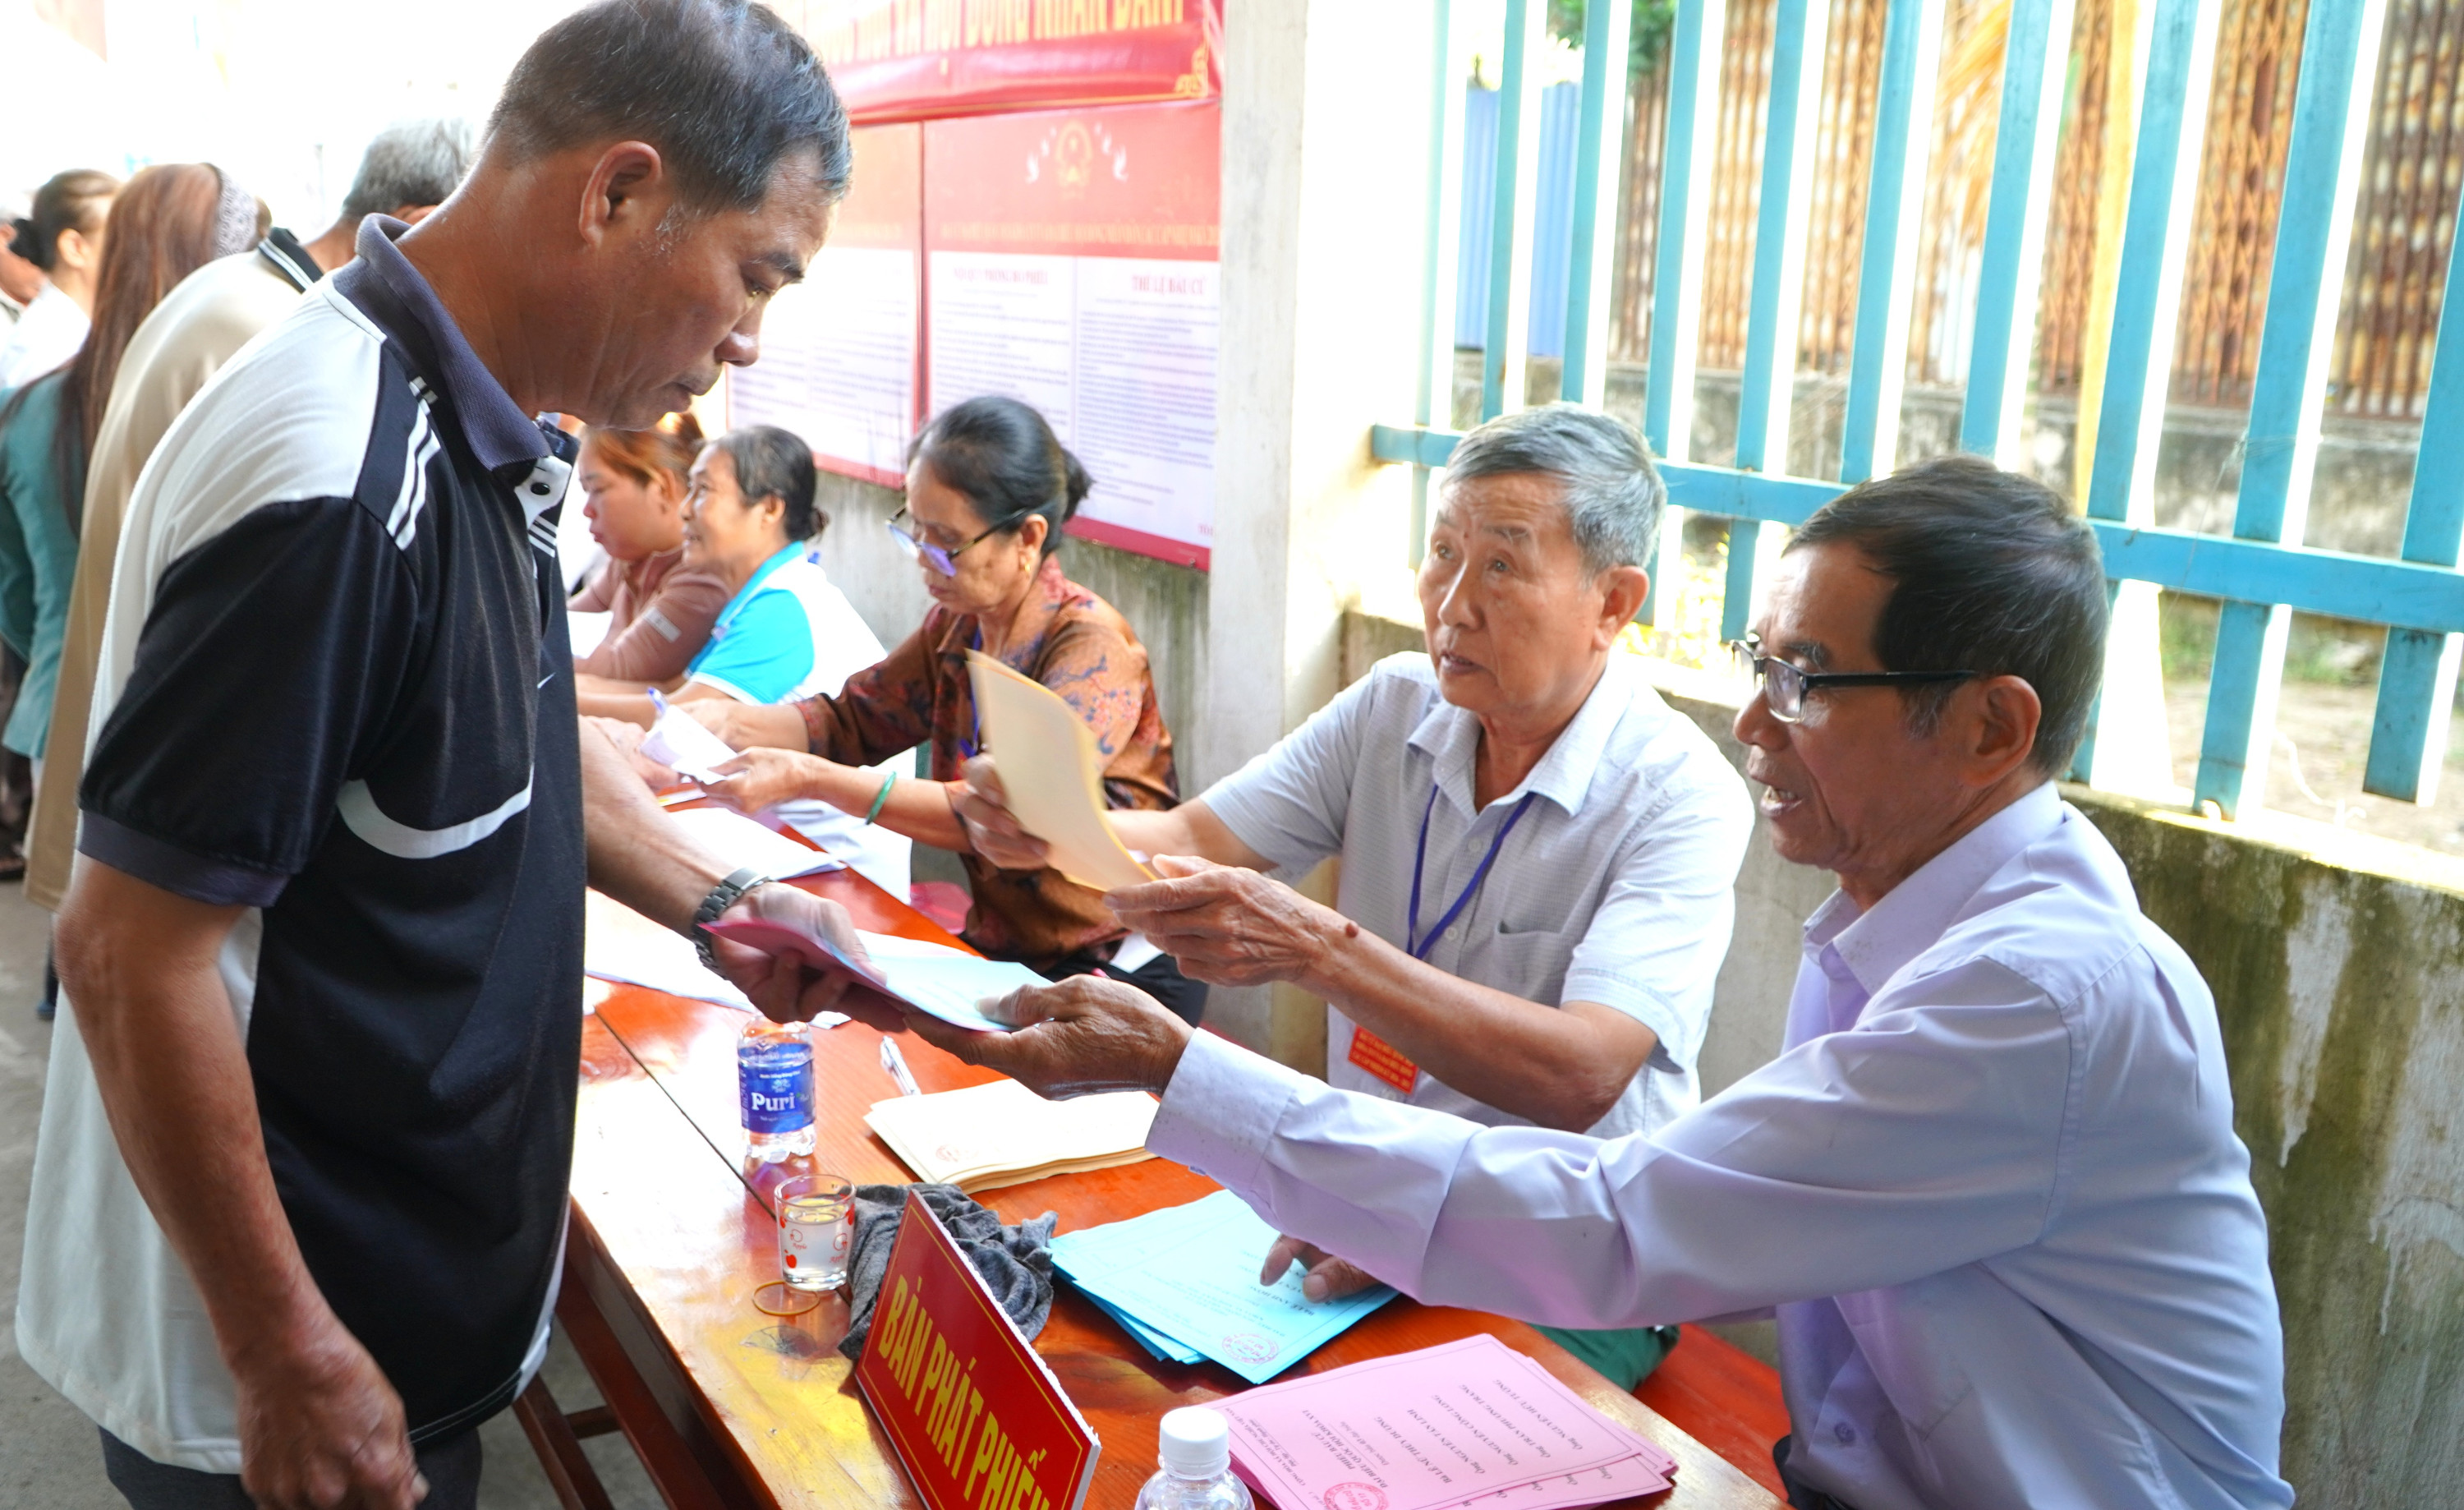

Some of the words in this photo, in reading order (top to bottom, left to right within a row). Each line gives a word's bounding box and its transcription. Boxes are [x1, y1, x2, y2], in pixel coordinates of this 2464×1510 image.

[751, 1092, 796, 1112] Puri
[878, 1274, 933, 1401] BÀN
[914, 1332, 984, 1480] PHÁT
[963, 1448, 1050, 1510] PHIẾ
